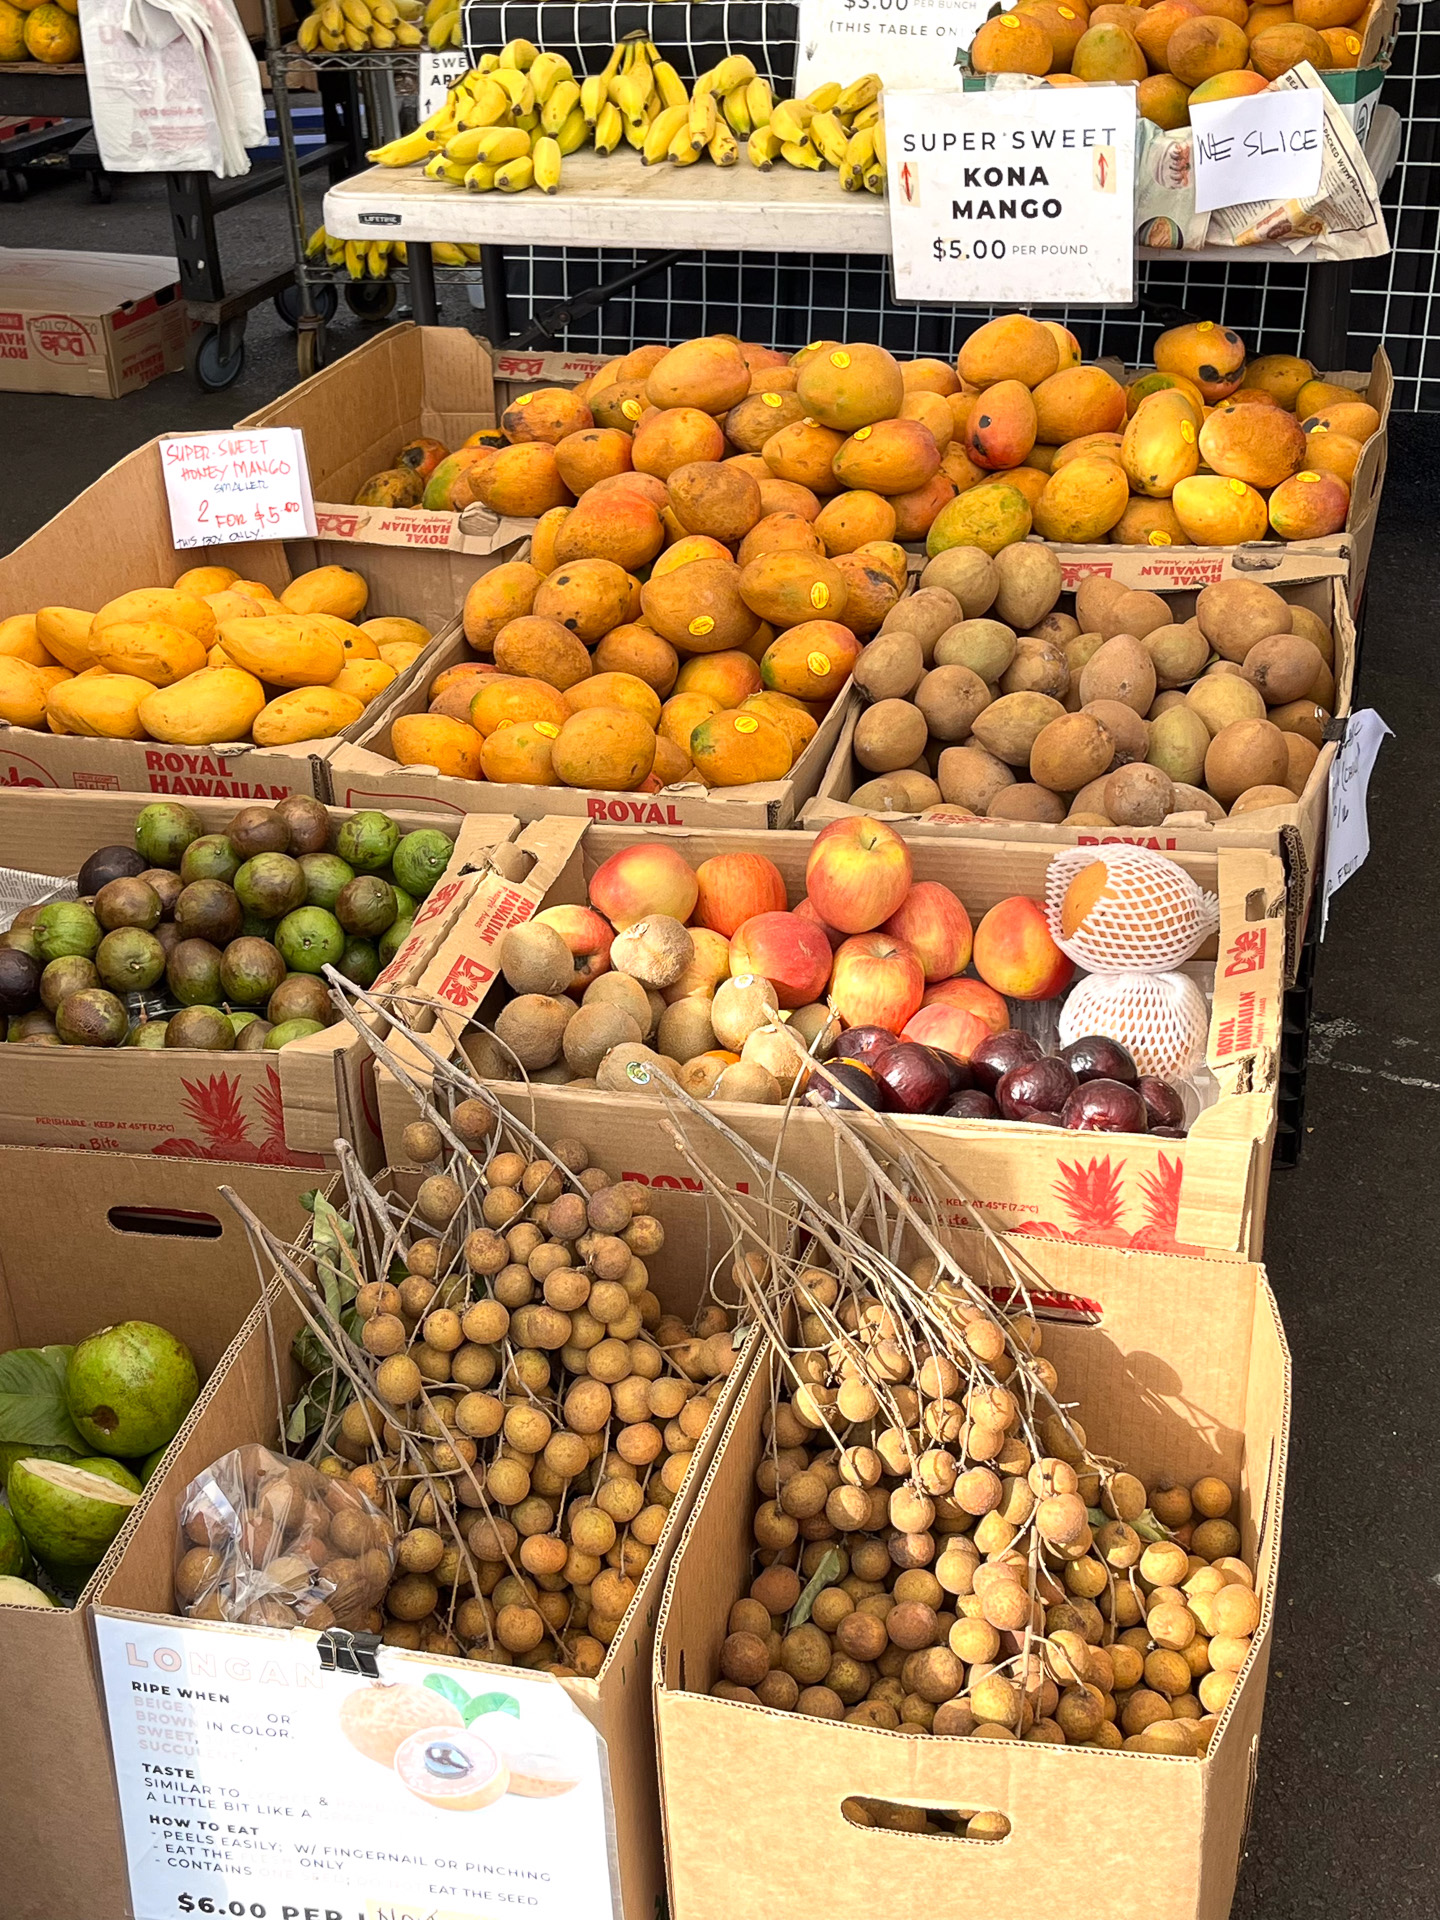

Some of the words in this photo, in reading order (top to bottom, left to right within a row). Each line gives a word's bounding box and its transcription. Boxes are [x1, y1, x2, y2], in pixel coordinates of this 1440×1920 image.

[880, 24, 928, 36] TABLE
[432, 57, 467, 69] SWE
[903, 132, 997, 152] SUPER
[1011, 127, 1117, 149] SWEET
[1243, 129, 1318, 158] SLICE
[963, 166, 1050, 188] KONA
[952, 198, 1063, 220] MANGO
[932, 236, 1007, 262] $5.00
[1012, 245, 1038, 255] PER
[1041, 244, 1089, 255] POUND
[40, 330, 85, 357] Dole
[497, 356, 545, 377] Dole
[181, 464, 229, 481] HONEY
[233, 459, 291, 478] MANGO
[213, 480, 269, 493] SMALLER
[197, 499, 209, 523] 2
[215, 513, 247, 529] FOR
[379, 521, 451, 534] HAWAIIAN
[202, 533, 223, 546] BOX
[406, 533, 449, 545] ROYAL
[1139, 564, 1223, 576] HAWAIIAN
[144, 750, 233, 778] ROYAL
[587, 798, 684, 826] ROYAL
[479, 889, 523, 947] HAWAIIAN
[1224, 927, 1267, 978] Dole
[437, 953, 495, 1007] Dole
[1235, 990, 1257, 1052] HAWAIIAN
[1216, 1017, 1236, 1057] ROYAL
[36, 1116, 87, 1128] PERISHABLE
[93, 1120, 115, 1129] KEEP
[89, 1136, 120, 1151] Bite
[125, 1642, 325, 1689] LONGAN
[131, 1680, 171, 1696] RIPE
[177, 1687, 230, 1704] WHEN
[133, 1695, 185, 1713] BEIGE
[267, 1713, 291, 1724] OR
[135, 1710, 199, 1729] BROWN
[206, 1720, 223, 1732] IN
[230, 1723, 295, 1740] COLOR.
[141, 1763, 195, 1779] TASTE
[144, 1777, 212, 1796] SIMILAR
[219, 1786, 240, 1798] TO
[319, 1796, 329, 1806] &
[146, 1791, 157, 1802] A
[163, 1793, 217, 1810] LITTLE
[224, 1801, 250, 1813] BIT
[257, 1805, 295, 1818] LIKE
[301, 1808, 312, 1819] A
[149, 1814, 190, 1829] HOW
[197, 1820, 220, 1832] TO
[228, 1824, 260, 1837] EAT
[163, 1830, 215, 1846] PEELS
[324, 1846, 428, 1867] FINGERNAIL
[434, 1857, 458, 1870] OR
[466, 1862, 552, 1883] PINCHING
[165, 1843, 196, 1857] EAT
[203, 1848, 234, 1861] THE
[300, 1857, 345, 1870] ONLY
[167, 1857, 253, 1876] CONTAINS
[429, 1884, 458, 1896] EAT
[462, 1888, 493, 1901] THE
[497, 1892, 539, 1906] SEED
[177, 1891, 267, 1919] $6.00
